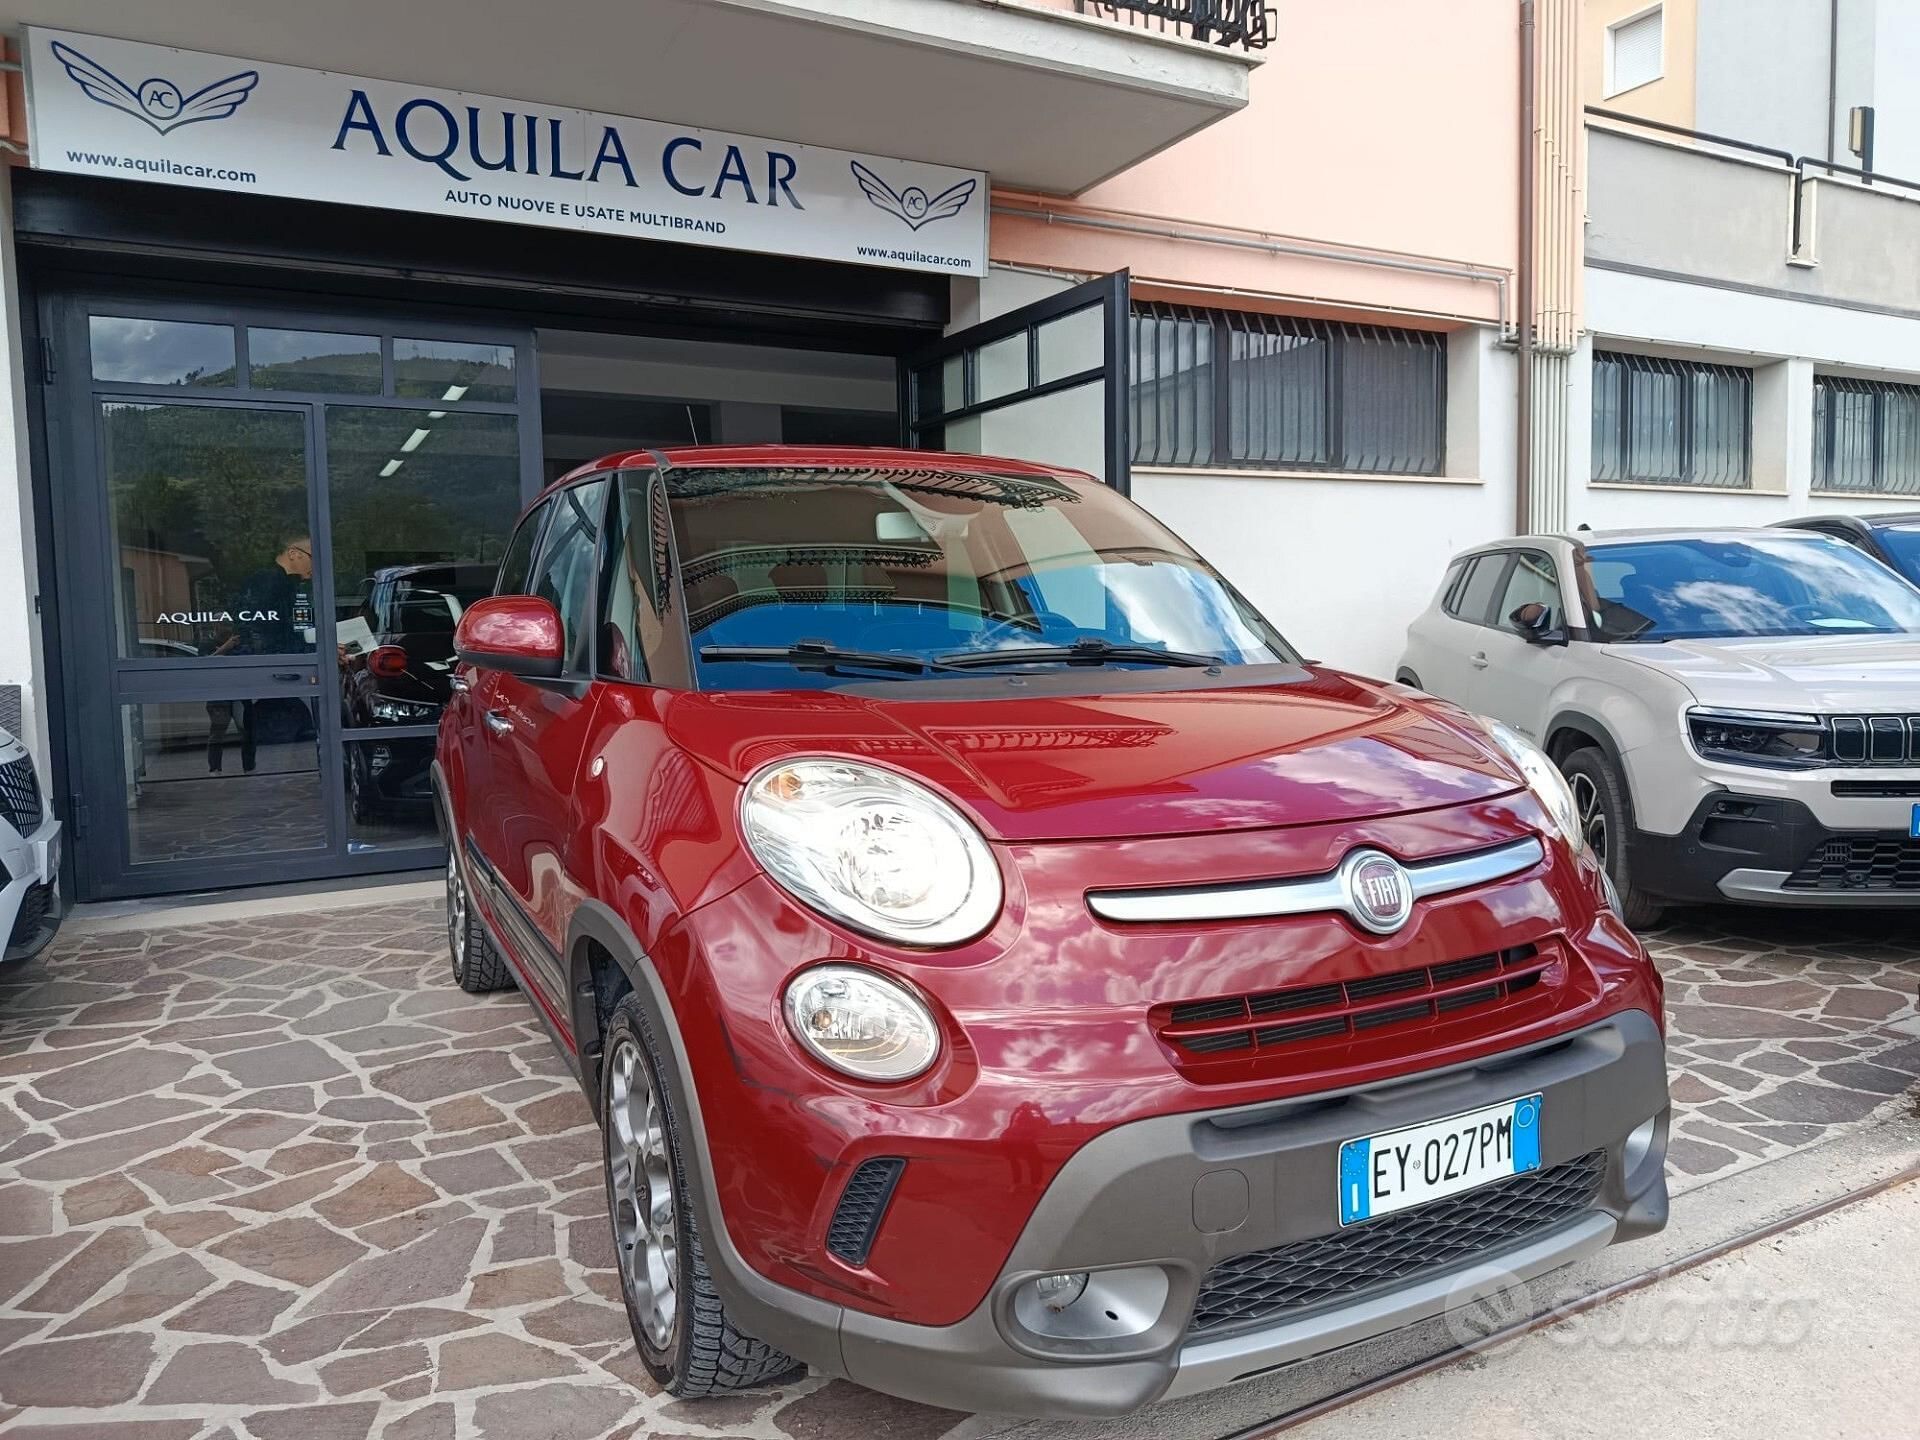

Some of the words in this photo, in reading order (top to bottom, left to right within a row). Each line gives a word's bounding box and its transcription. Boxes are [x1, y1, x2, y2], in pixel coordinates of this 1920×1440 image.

[148, 90, 174, 109] AC
[330, 89, 640, 188] AQUILA
[662, 136, 806, 211] CAR
[66, 150, 256, 183] www.aquilacar.com
[445, 189, 492, 207] AUTO
[497, 196, 556, 215] NUOVE
[560, 203, 570, 216] E
[574, 204, 626, 223] USATE
[630, 211, 727, 235] MULTIBRAND
[907, 196, 923, 210] AC
[857, 246, 971, 268] www.aquilacar.com
[156, 611, 233, 625] AQUILA
[238, 610, 280, 622] CAR
[1366, 875, 1399, 907] FIAT
[1374, 1143, 1412, 1198] EY
[1424, 1115, 1513, 1185] 027PM
